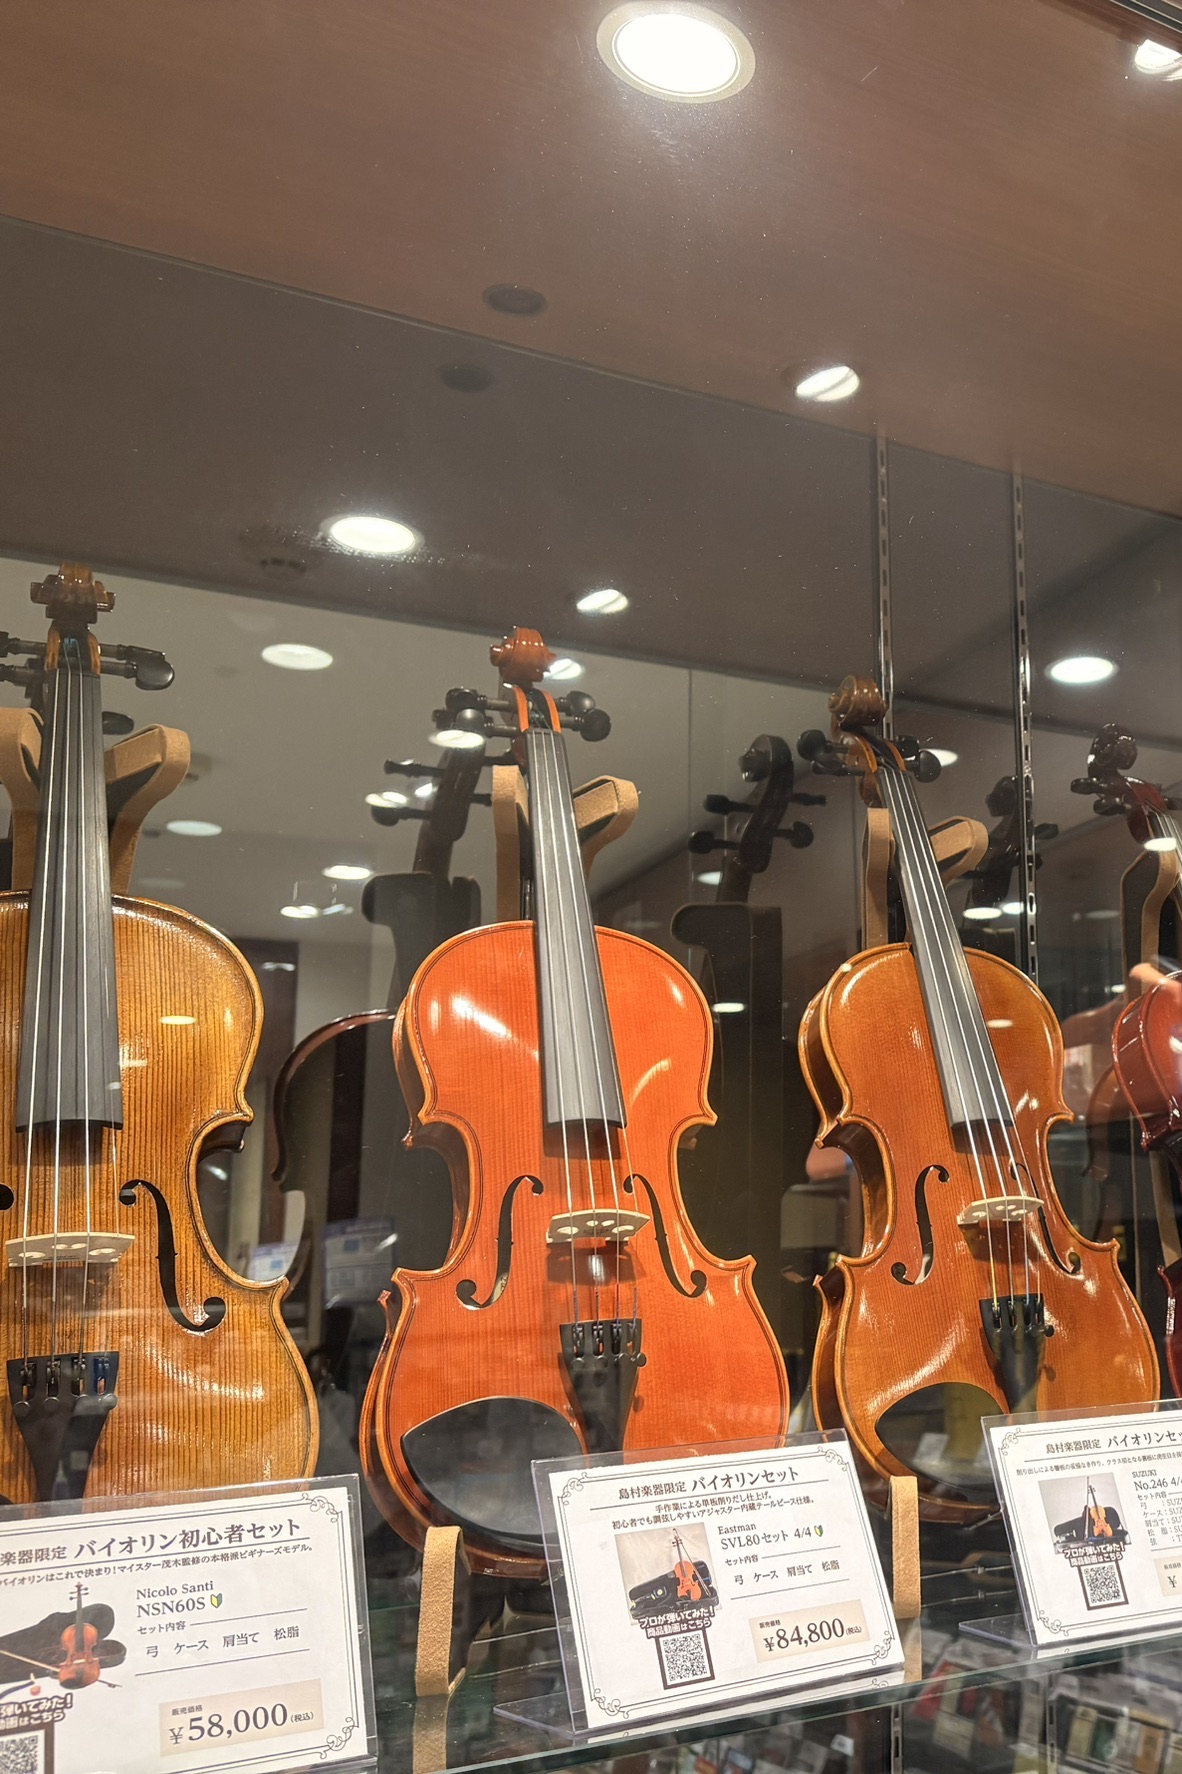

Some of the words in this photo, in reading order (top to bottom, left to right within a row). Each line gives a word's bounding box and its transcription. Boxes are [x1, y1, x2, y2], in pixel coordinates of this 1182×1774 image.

[1046, 1438, 1101, 1454] 島村楽器限定
[618, 1481, 687, 1500] 島村楽器限定
[692, 1466, 799, 1492] バイオリンセット
[1131, 1469, 1157, 1478] SUZUKI
[1133, 1478, 1168, 1491] No.246
[74, 1518, 300, 1559] バイオリン初心者セット
[717, 1523, 757, 1535] Eastman
[794, 1526, 812, 1539] 4/4
[725, 1554, 759, 1566] セット内容
[734, 1574, 744, 1585] 弓
[753, 1570, 779, 1583] ケース
[786, 1564, 813, 1577] 肩当て
[821, 1559, 840, 1572] 松脂
[136, 1585, 178, 1600] Nicolo
[182, 1580, 214, 1594] Santi
[136, 1597, 206, 1618] NSN60S
[640, 1605, 715, 1628] プロが弾いてみた！
[137, 1620, 186, 1635] セット内容
[763, 1618, 845, 1652] ¥84,800
[146, 1645, 159, 1658] 弓
[174, 1639, 209, 1655] ケース
[222, 1632, 260, 1648] 肩当て
[273, 1625, 300, 1641] 松脂
[169, 1703, 288, 1745] ¥58,000
